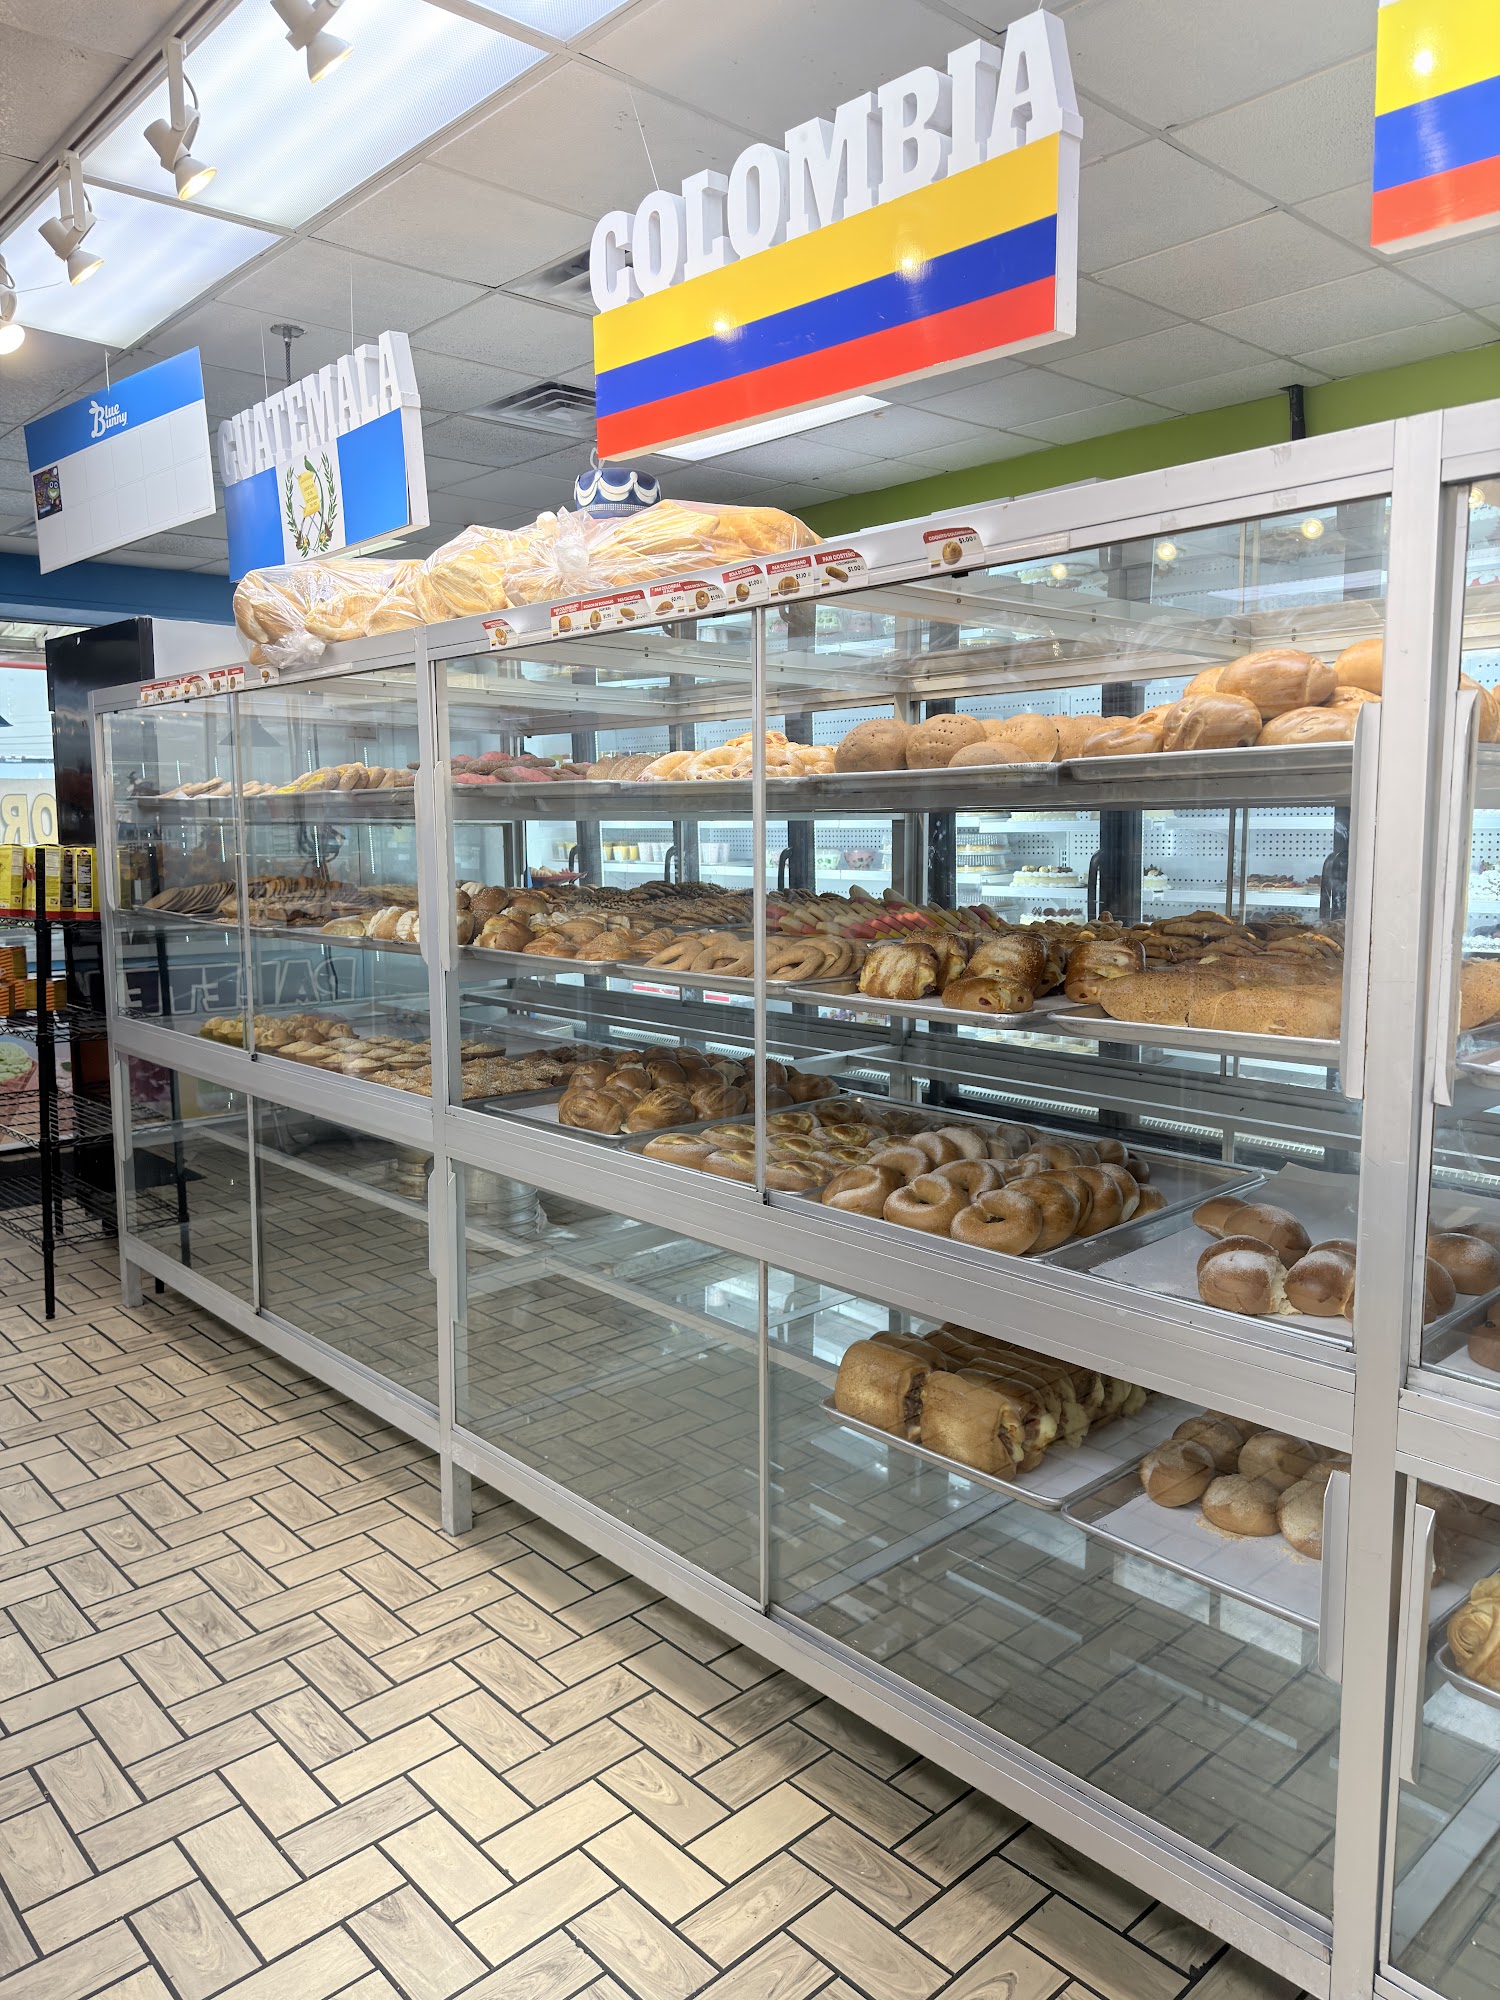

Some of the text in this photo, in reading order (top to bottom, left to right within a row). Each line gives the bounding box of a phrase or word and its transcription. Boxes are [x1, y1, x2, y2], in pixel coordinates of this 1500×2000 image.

[590, 8, 1080, 314] COLOMBIA
[91, 407, 128, 438] Bunny
[217, 329, 415, 488] GUATEMALA
[821, 551, 856, 563] PAN COSTEÑO
